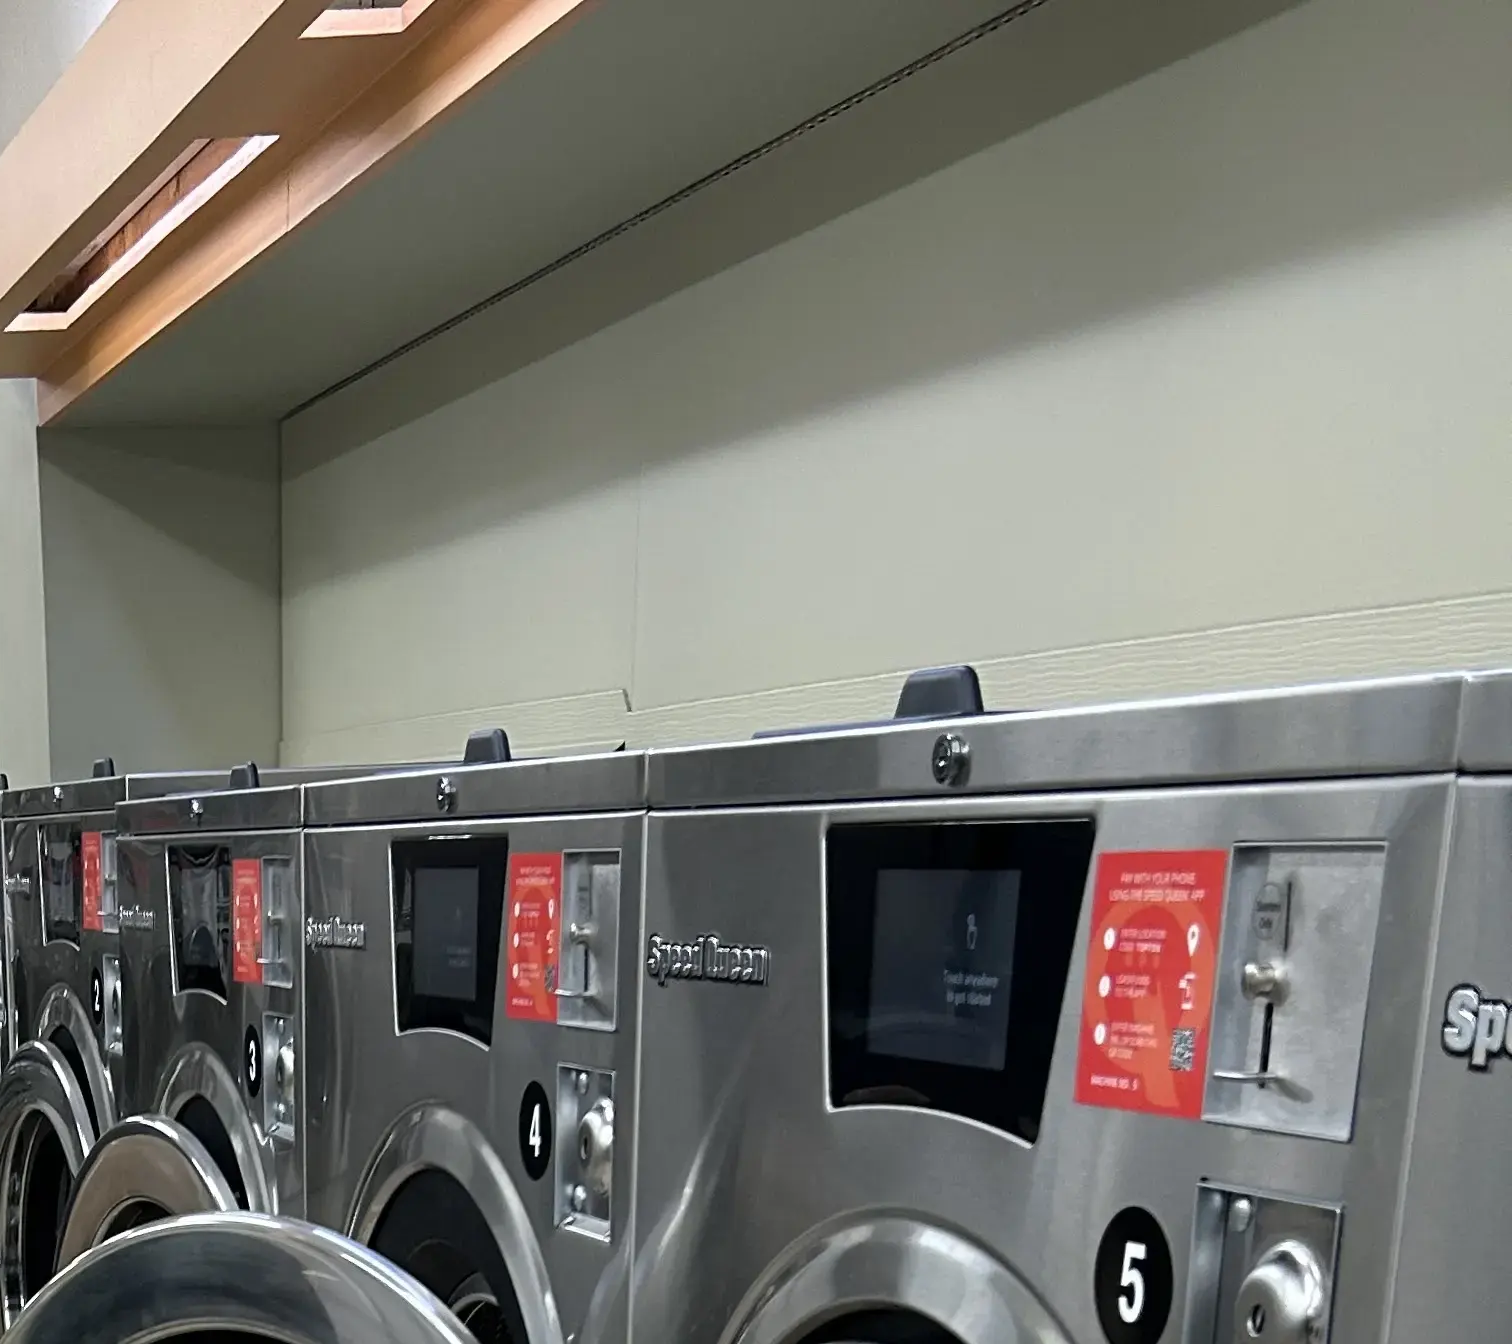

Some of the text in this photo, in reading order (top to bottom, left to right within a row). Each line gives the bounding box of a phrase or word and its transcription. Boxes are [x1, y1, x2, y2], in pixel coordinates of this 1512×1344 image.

[646, 935, 769, 986] Speed Queen
[94, 978, 100, 1012] 2
[1441, 986, 1512, 1068] Sp
[249, 1039, 256, 1082] 3
[528, 1102, 542, 1158] 4
[1117, 1240, 1148, 1324] 5
